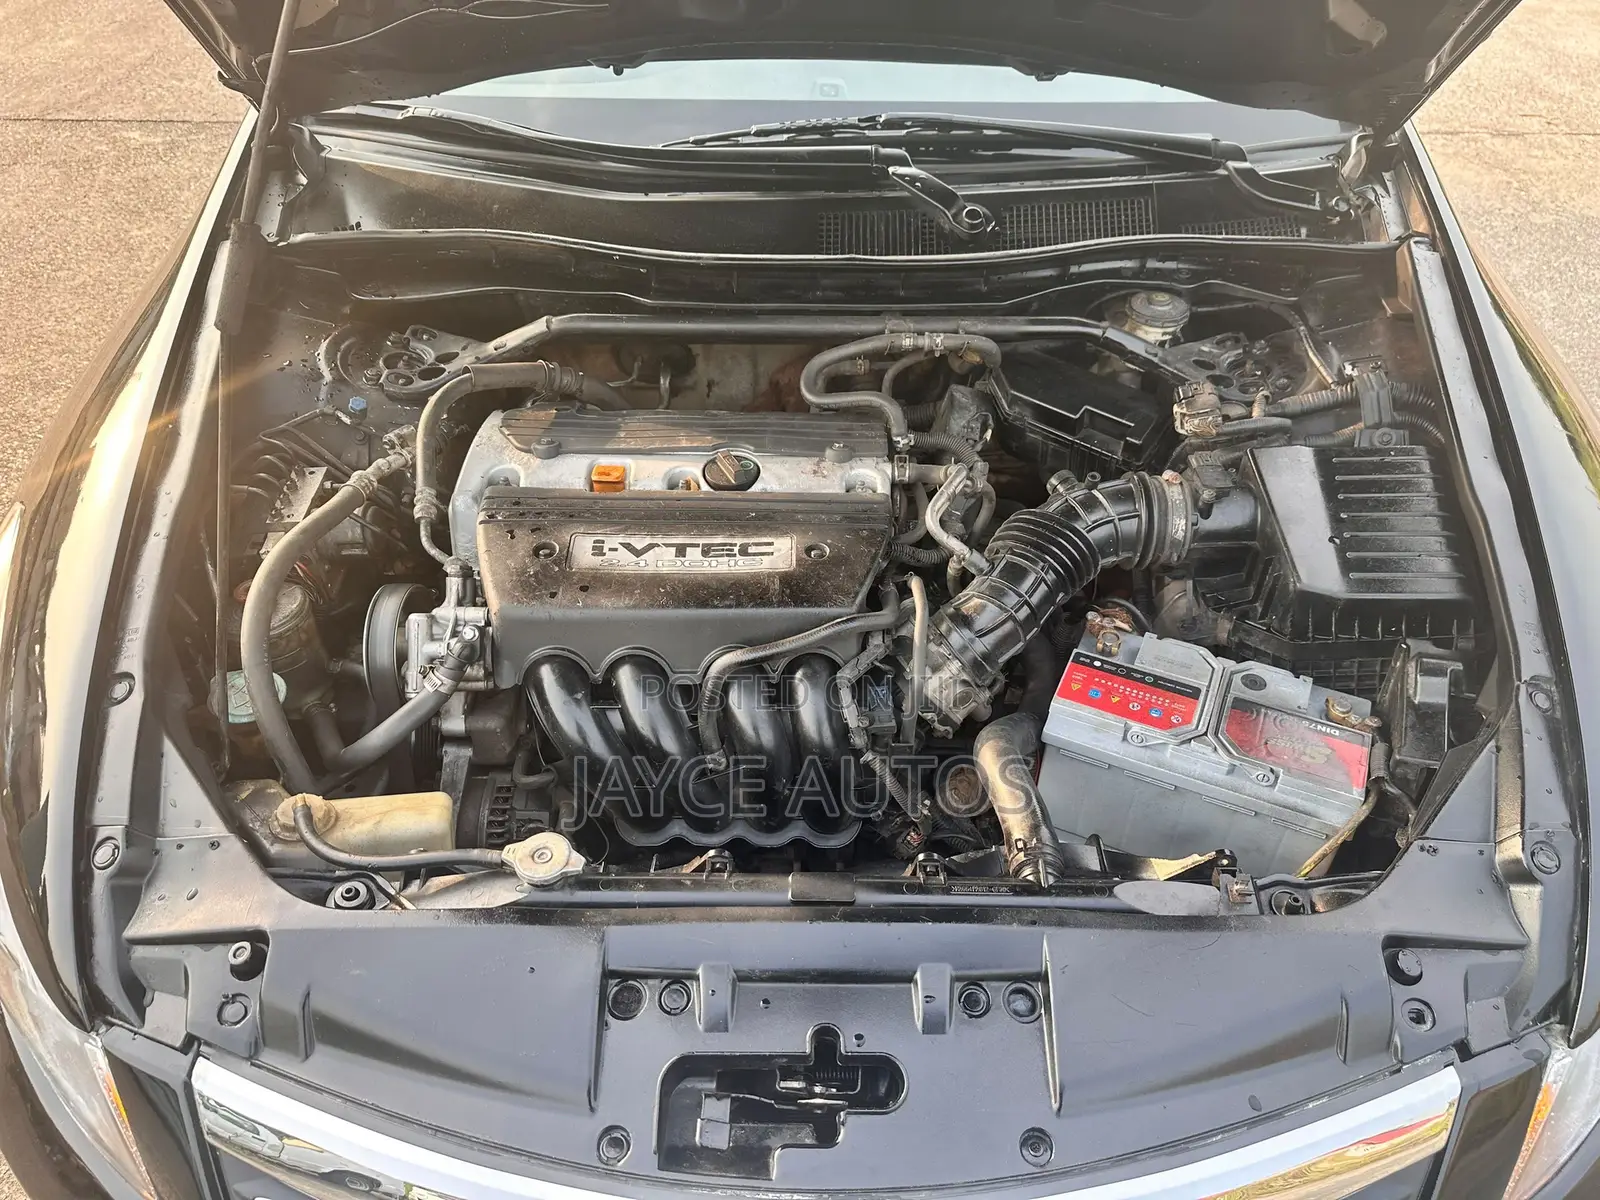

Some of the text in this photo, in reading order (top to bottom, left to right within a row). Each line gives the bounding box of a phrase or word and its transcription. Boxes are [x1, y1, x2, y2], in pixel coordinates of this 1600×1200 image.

[590, 539, 775, 559] i-VTEC
[599, 557, 764, 568] 2.4 DOHC
